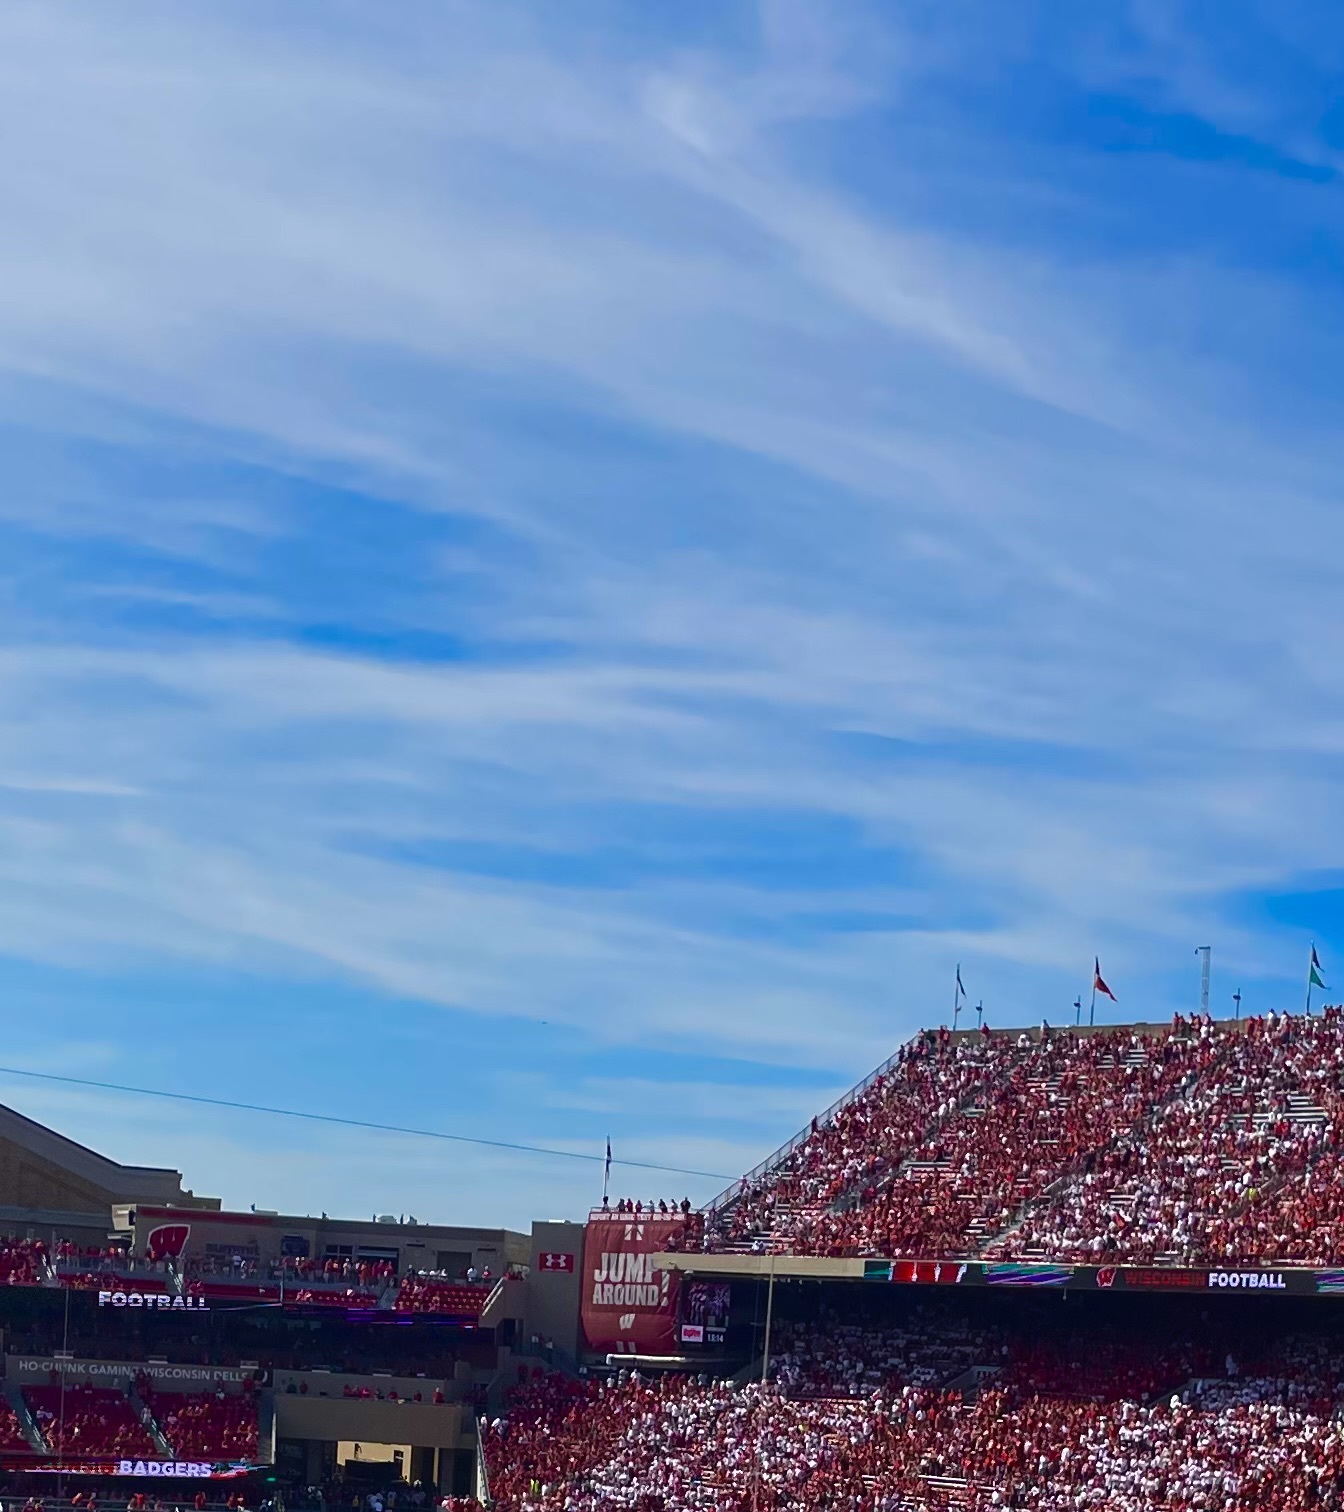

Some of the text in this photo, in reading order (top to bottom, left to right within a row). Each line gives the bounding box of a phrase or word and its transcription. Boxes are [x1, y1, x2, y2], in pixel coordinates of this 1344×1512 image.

[593, 1252, 658, 1283] JUMP
[1208, 1272, 1286, 1289] FOOTBALL
[98, 1290, 211, 1311] FOOTBALL
[142, 1367, 211, 1382] WISCONSIN
[120, 1459, 212, 1478] BADGERS
